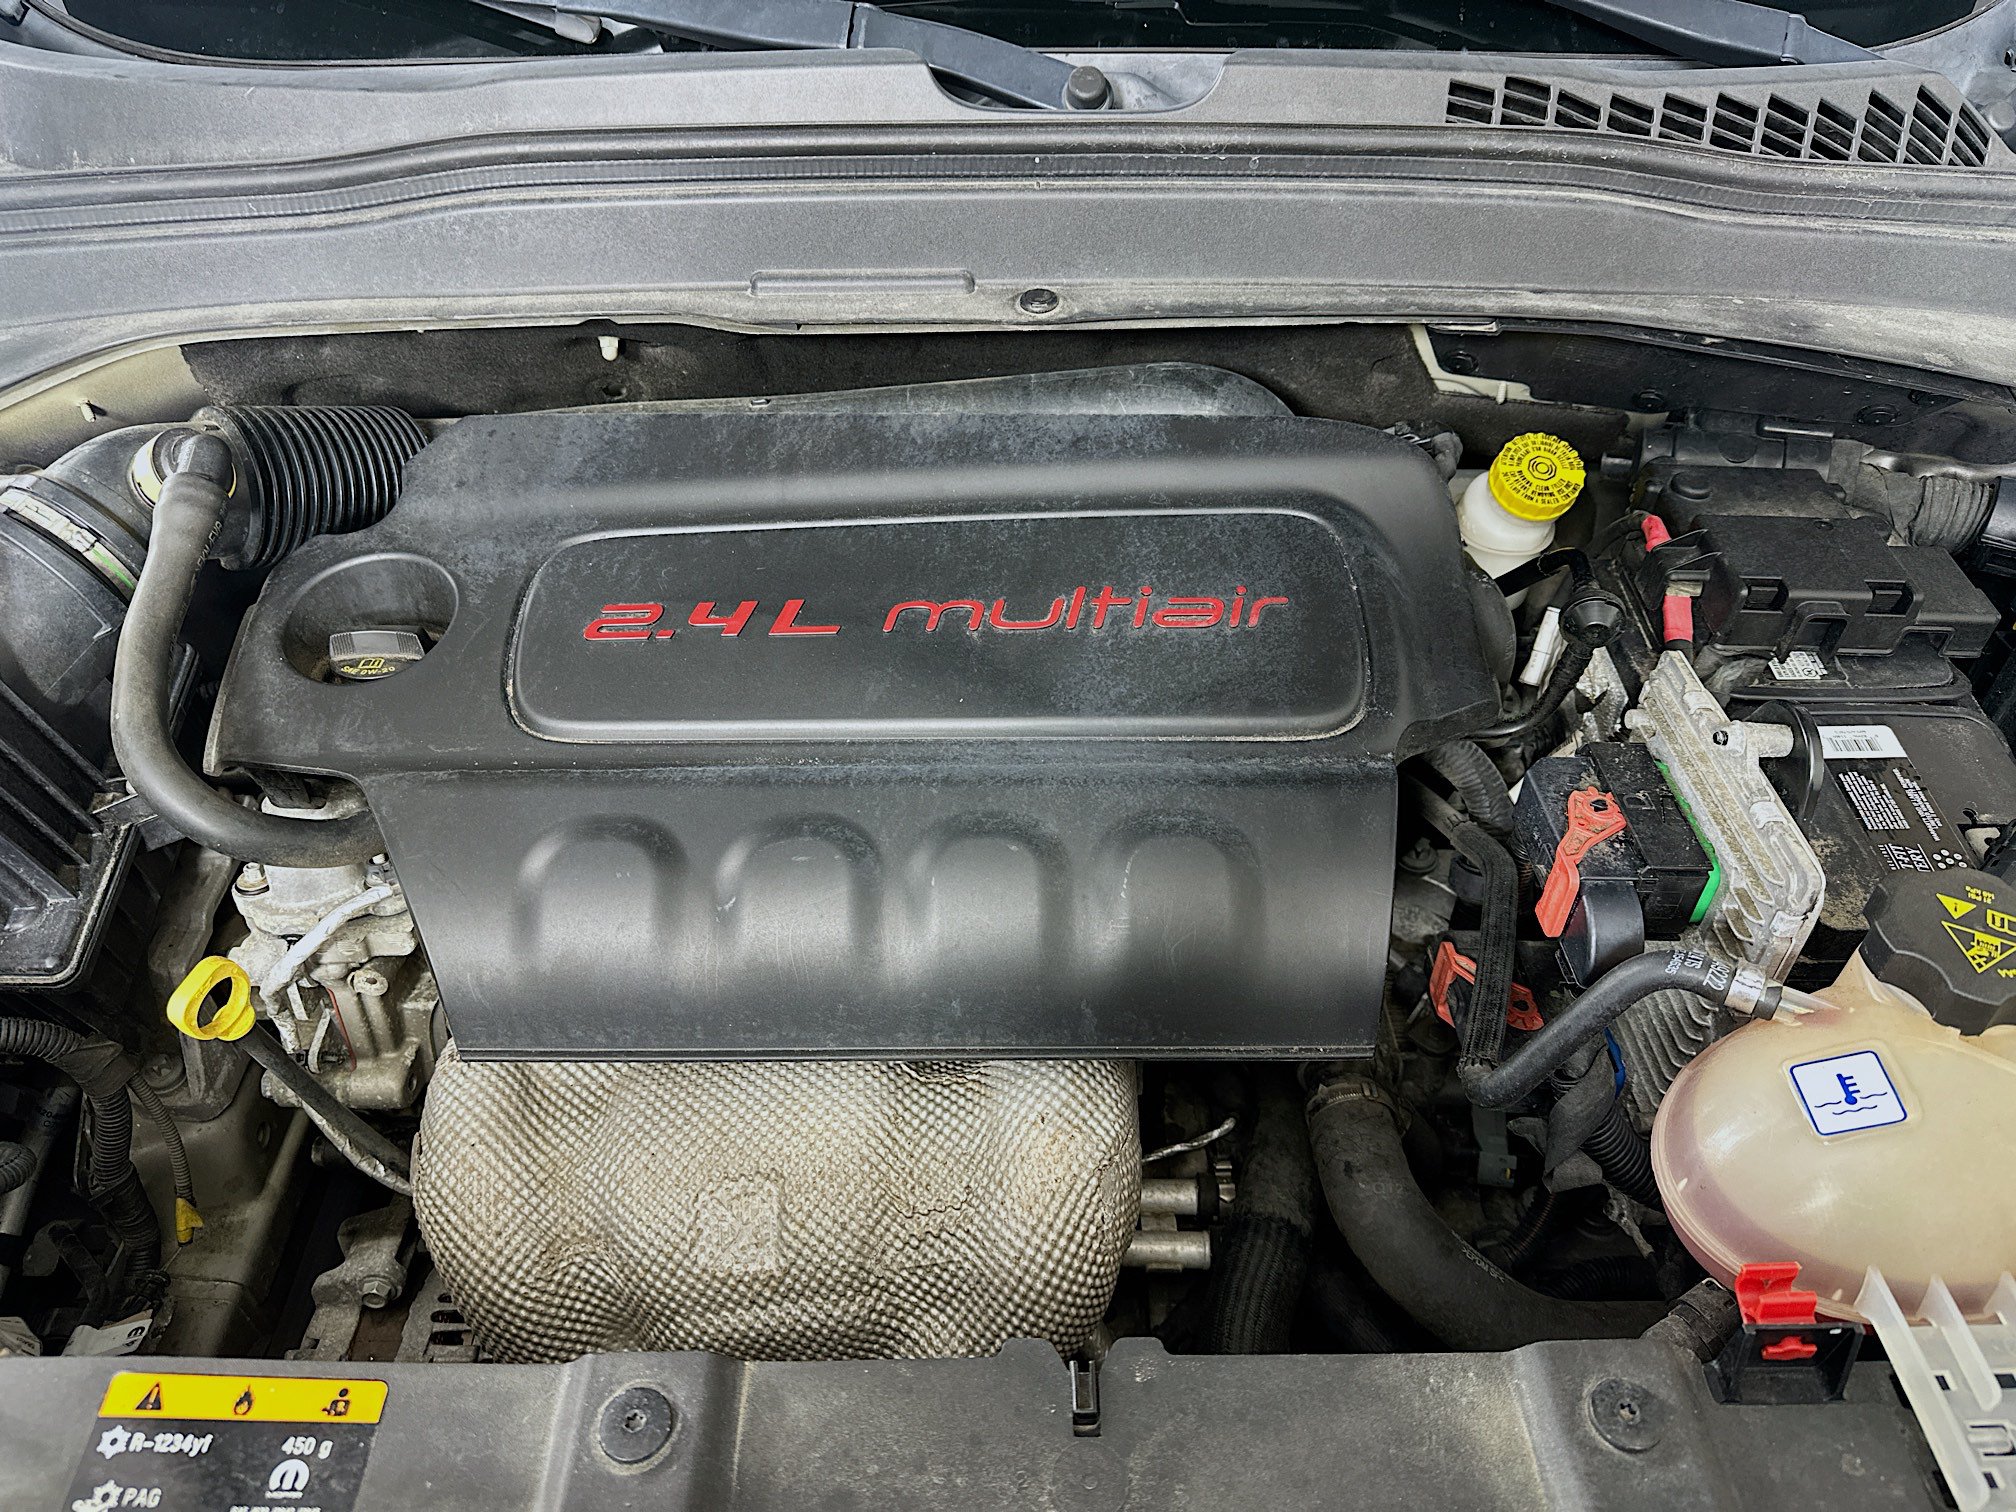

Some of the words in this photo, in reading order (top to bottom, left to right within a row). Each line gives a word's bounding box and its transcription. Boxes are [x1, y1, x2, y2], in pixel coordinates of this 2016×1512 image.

[882, 585, 1290, 633] multiair
[341, 665, 359, 675] SAE
[360, 666, 396, 675] 0W-20
[129, 1433, 214, 1458] R-1234yf
[281, 1436, 317, 1456] 450
[318, 1439, 333, 1460] g
[121, 1487, 162, 1509] PAG
